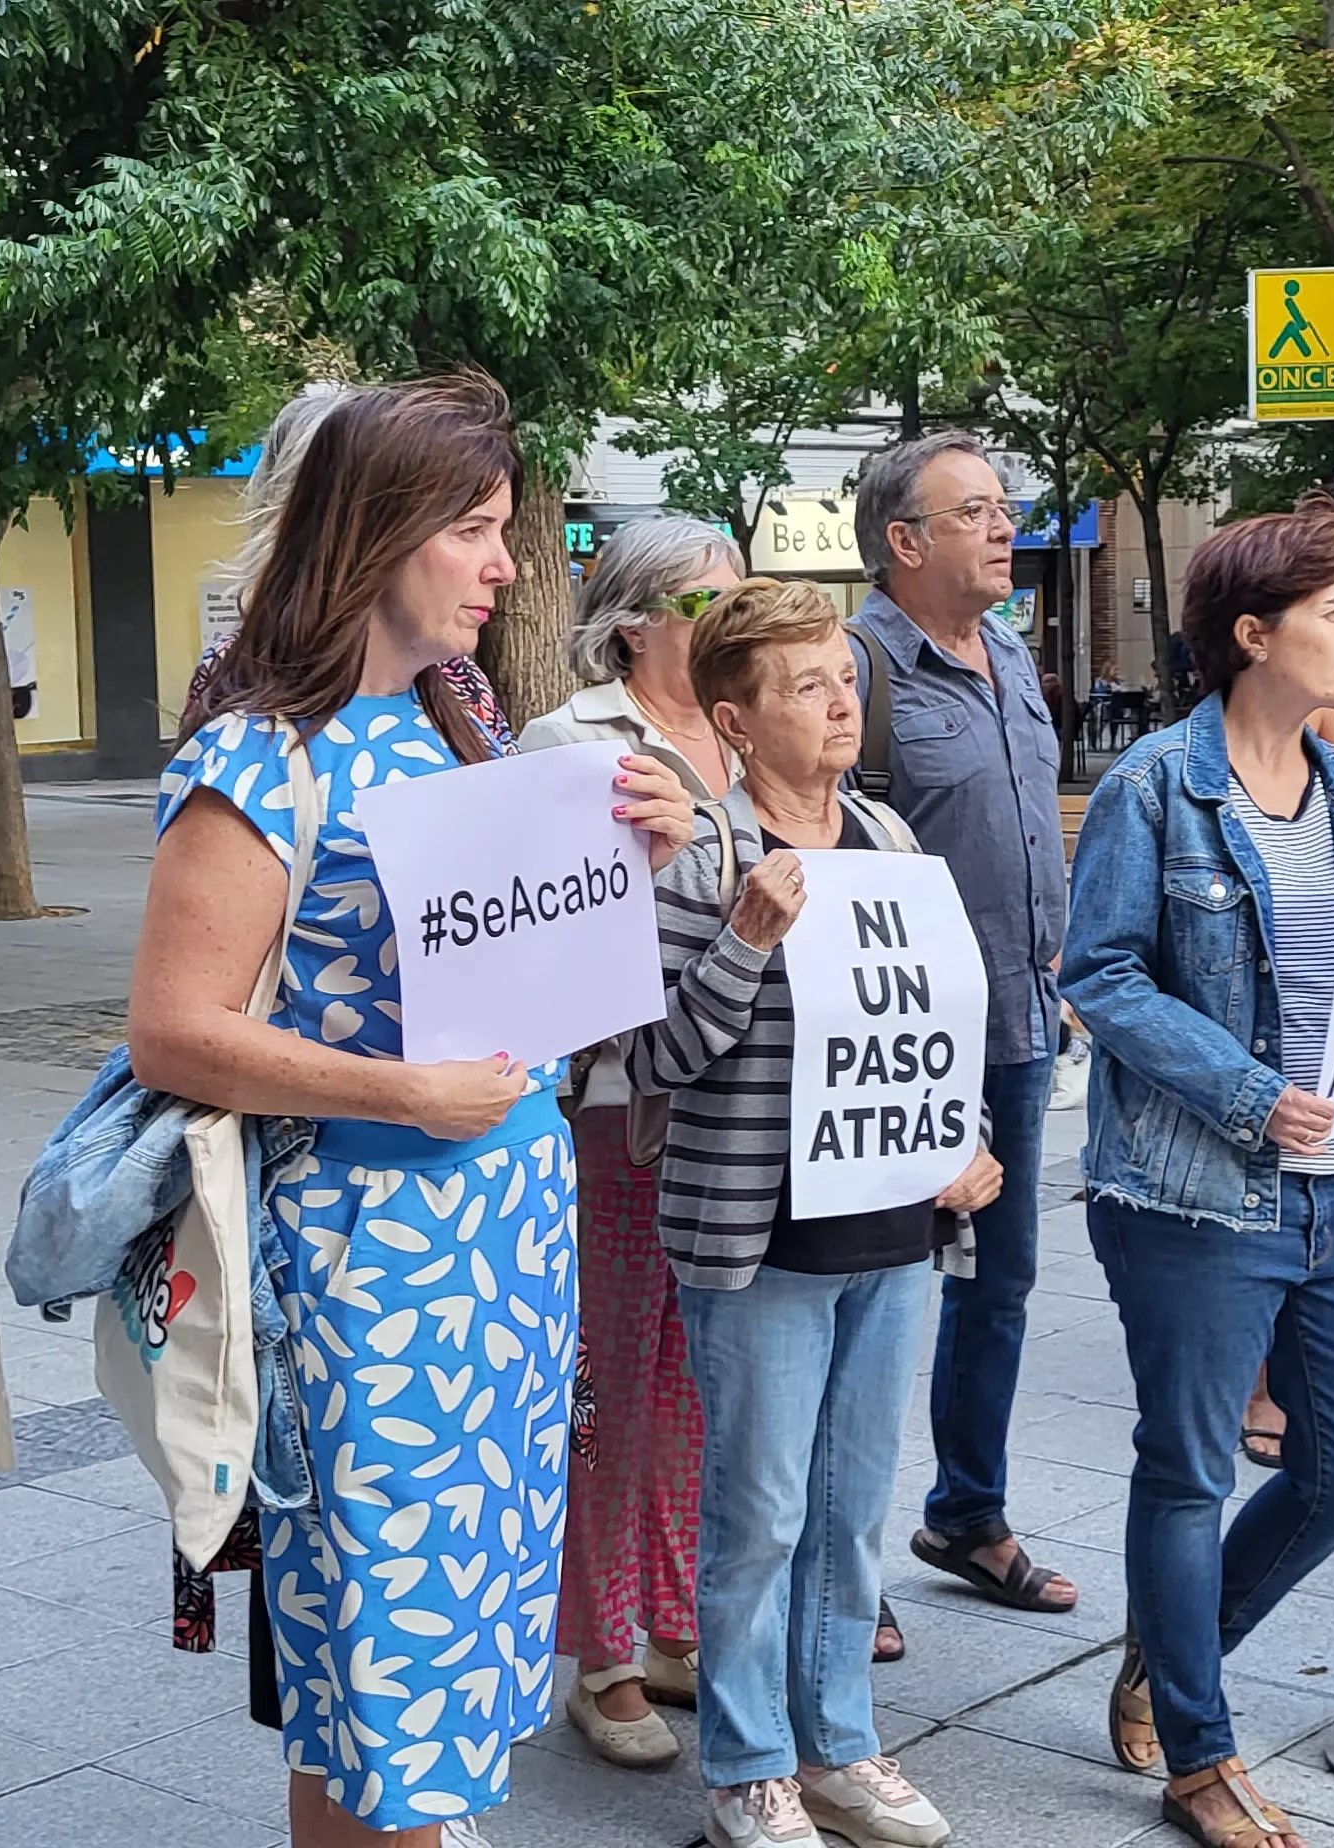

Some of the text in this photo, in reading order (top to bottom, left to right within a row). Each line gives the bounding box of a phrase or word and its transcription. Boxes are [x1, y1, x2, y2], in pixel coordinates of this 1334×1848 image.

[773, 522, 854, 552] Be & C
[420, 847, 629, 957] #SeAcabó
[851, 900, 909, 949] NI
[851, 964, 931, 1016] UN
[825, 1030, 956, 1088] PASO
[807, 1087, 967, 1163] ATRÁS
